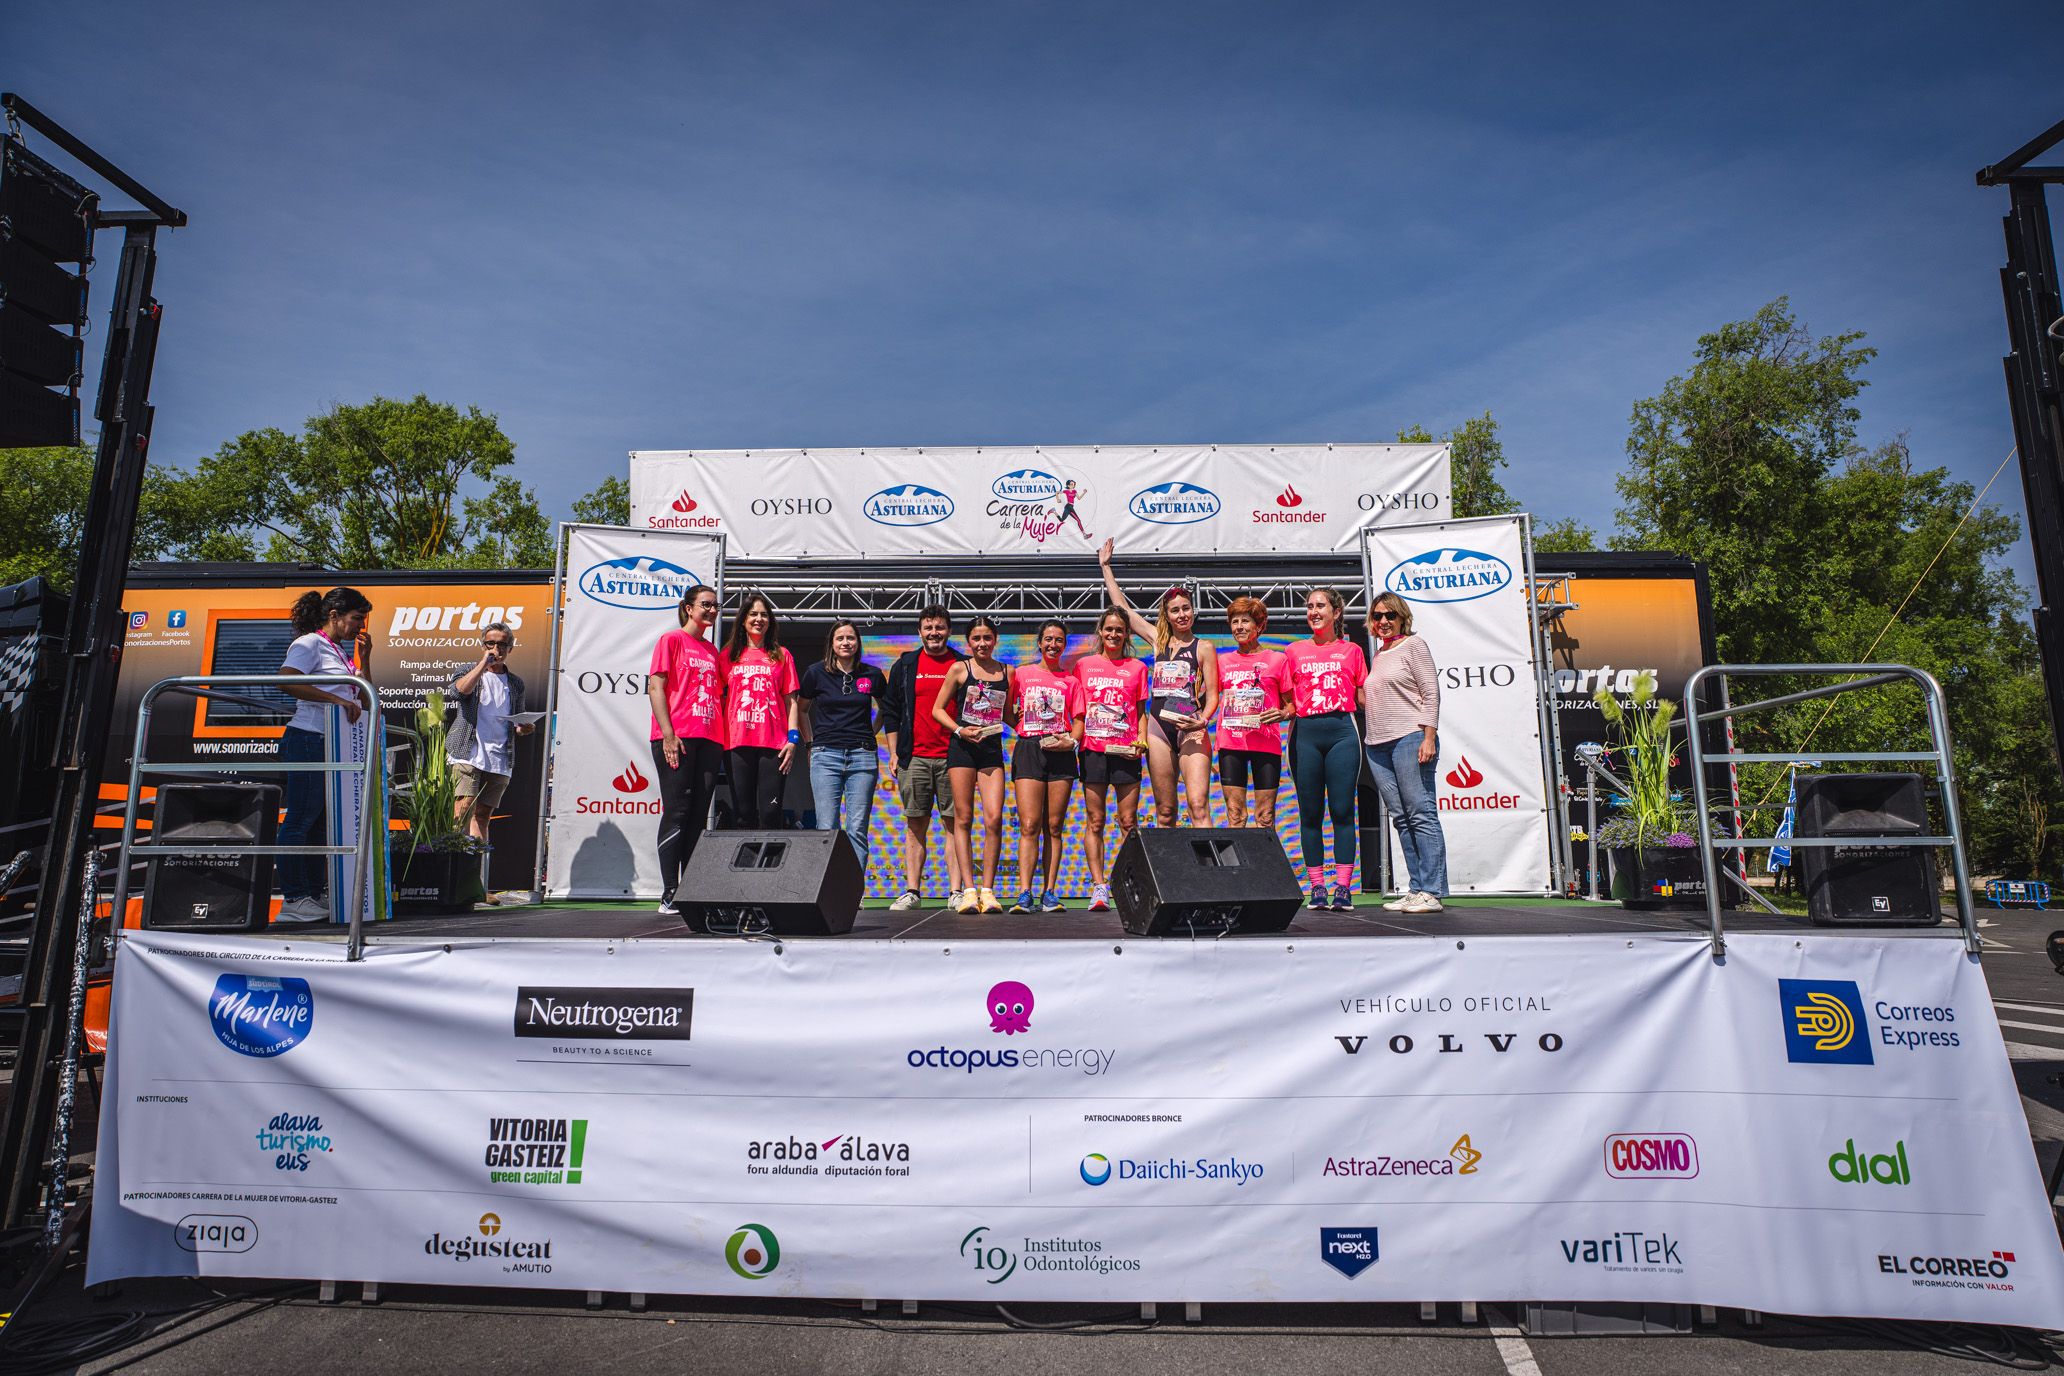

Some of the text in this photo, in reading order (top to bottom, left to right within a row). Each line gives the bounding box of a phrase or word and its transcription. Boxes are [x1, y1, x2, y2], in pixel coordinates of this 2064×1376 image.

[998, 481, 1057, 494] ASTURIANA
[751, 498, 833, 517] OYSHO
[871, 500, 947, 516] ASTURIANA
[986, 499, 1044, 517] Carrera
[1136, 498, 1214, 514] ASTURIANA
[1357, 492, 1439, 511] OYSHO
[648, 515, 721, 529] Santander
[1000, 518, 1021, 529] de la
[1252, 510, 1327, 523] Santander
[1019, 514, 1065, 543] Mujer
[1413, 563, 1498, 575] CENTRAL LECHERA
[1395, 570, 1503, 592] ASTURIANA
[388, 602, 524, 636] portos
[124, 639, 191, 647] onorizacionesPortos
[387, 637, 483, 647] SONORIZACION
[400, 660, 430, 670] Rampa
[432, 660, 444, 669] de
[733, 665, 772, 676] CARRERA
[1301, 661, 1342, 674] CARRERA
[411, 673, 444, 682] Tarimas
[577, 671, 651, 696] OYS
[753, 677, 766, 692] DE
[1087, 677, 1124, 688] CARRERA
[1437, 664, 1516, 689] SHO
[1543, 665, 1659, 693] ortos
[378, 686, 414, 697] Soporte
[415, 688, 435, 697] para
[737, 710, 766, 723] MUJER
[193, 740, 279, 754] www.sonorizacio
[576, 796, 664, 815] Santand
[1439, 792, 1521, 811] ntander
[148, 947, 205, 958] PATROCINADORES
[206, 951, 218, 959] DEL
[220, 952, 252, 960] CIRCUITO
[214, 991, 308, 1035] Marlene
[1340, 995, 1551, 1014] VEHÍCULO OFICIAL
[1875, 1001, 1955, 1022] Correos
[526, 997, 679, 1034] Neutrogena
[221, 1031, 294, 1054] HIJA DE LOS ALPES
[1335, 1033, 1563, 1055] VOLVO
[1881, 1026, 1961, 1051] Express
[552, 1046, 653, 1057] BEAUTY TO A SCIENCE
[907, 1046, 1115, 1076] octopus energy
[136, 1095, 189, 1103] INSTITUCIONES
[269, 1112, 323, 1132] alava
[1084, 1114, 1182, 1123] PATROCINADORES BRONCE
[489, 1118, 567, 1142] VITORIA
[485, 1143, 565, 1168] GASTEIZ
[748, 1136, 910, 1162] araba álava
[1612, 1139, 1690, 1171] COSMO
[1323, 1156, 1454, 1177] AstraZeneca
[1828, 1138, 1911, 1186] dial
[491, 1169, 563, 1186] green capital
[747, 1164, 910, 1179] foru aldundia diputación foral
[1119, 1157, 1264, 1186] Daiichi-Sankyo
[123, 1192, 191, 1200] PATROCINADORES
[192, 1193, 223, 1201] CARRERA
[244, 1194, 268, 1202] MUJER
[269, 1195, 279, 1203] DE
[279, 1195, 338, 1204] VITORIA-GASTEIZ
[424, 1232, 553, 1262] degusteat
[1024, 1237, 1101, 1253] Institutos
[1329, 1240, 1371, 1253] next
[1560, 1232, 1682, 1264] variTek
[502, 1263, 552, 1274] by AMUTIO
[1024, 1255, 1141, 1275] Odontológicos
[1878, 1254, 2009, 1279] EL CORREO
[1912, 1278, 2015, 1292] INFORMACIÓN CON VALOR
